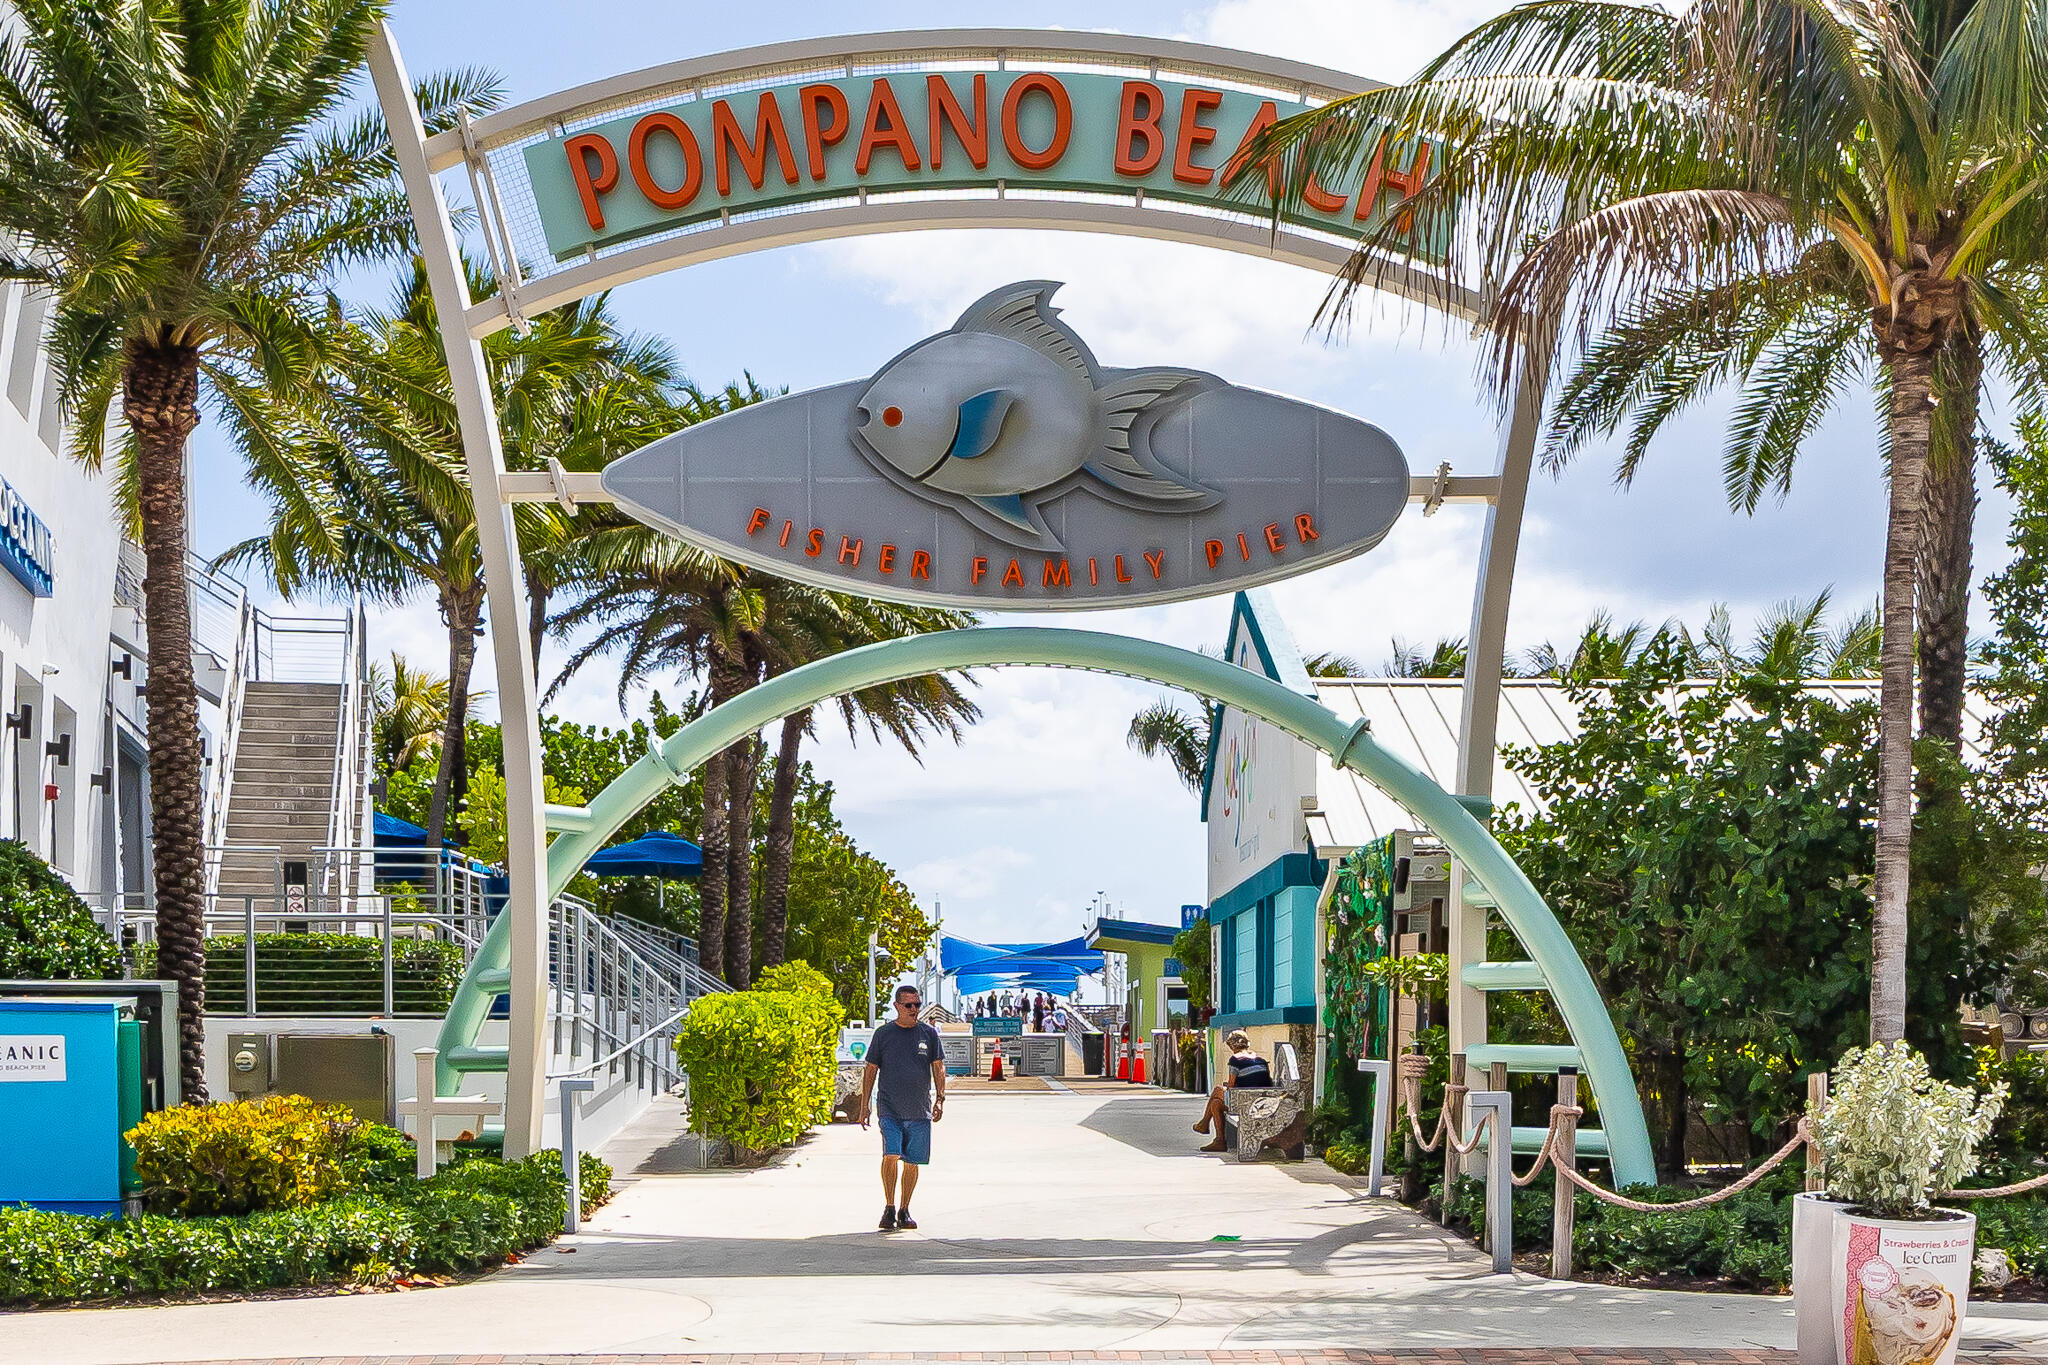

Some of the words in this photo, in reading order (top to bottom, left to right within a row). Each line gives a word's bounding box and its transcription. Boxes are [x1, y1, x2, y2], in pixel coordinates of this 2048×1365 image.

[563, 73, 1073, 231] POMPANO
[746, 507, 931, 580] FISHER
[971, 549, 1165, 588] FAMILY
[1205, 512, 1320, 569] PIER
[0, 1045, 59, 1060] ANIC
[1884, 1239, 1942, 1249] Strawberries
[1944, 1240, 1950, 1249] &
[1903, 1250, 1921, 1264] Ice
[1922, 1251, 1957, 1265] Cream
